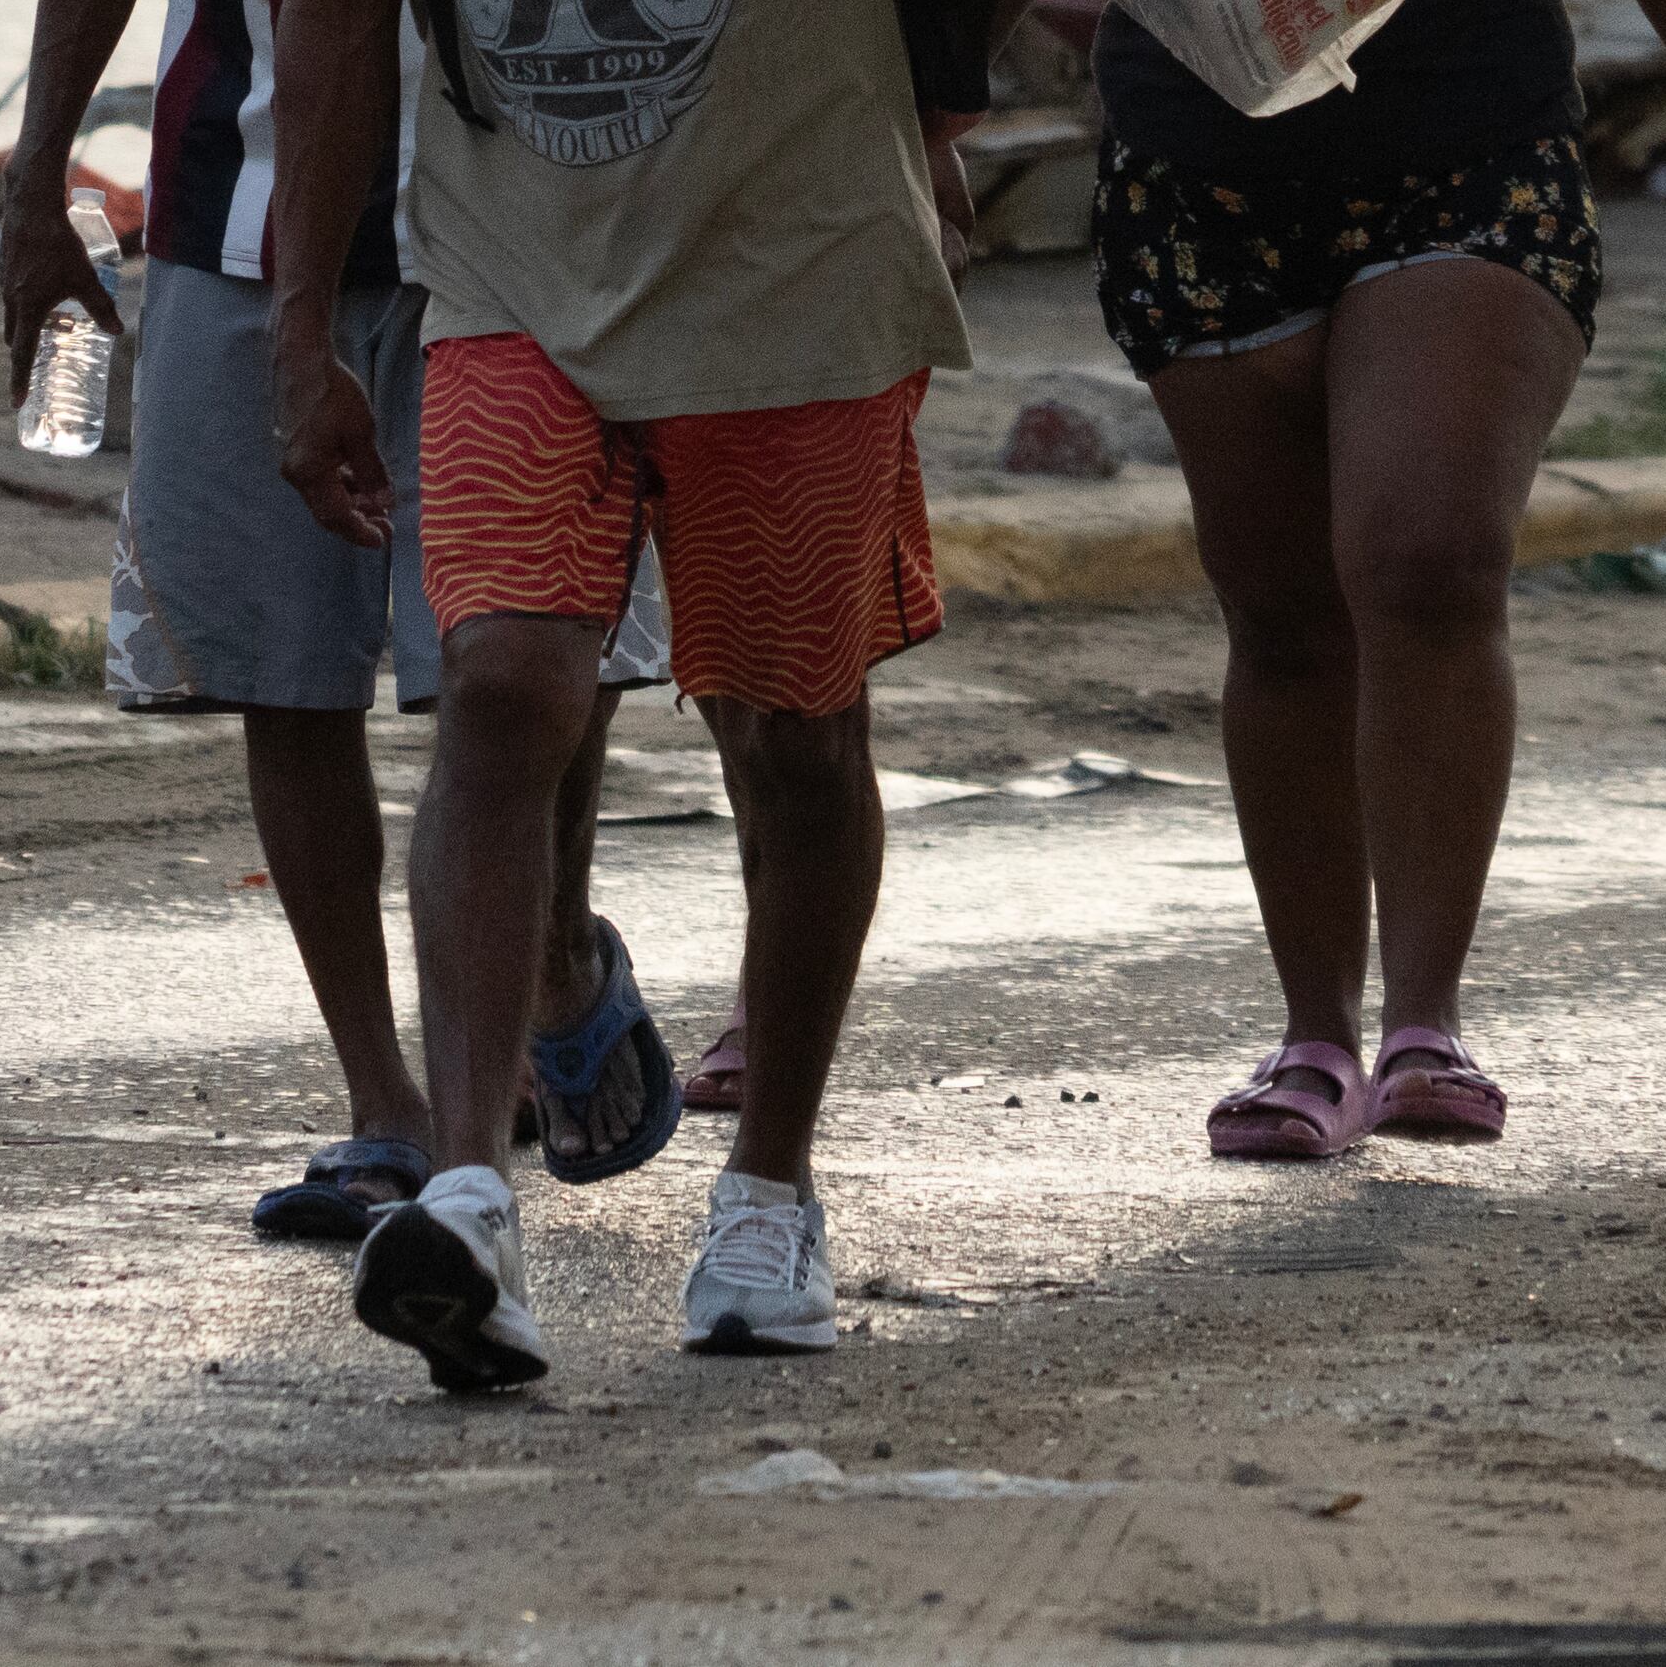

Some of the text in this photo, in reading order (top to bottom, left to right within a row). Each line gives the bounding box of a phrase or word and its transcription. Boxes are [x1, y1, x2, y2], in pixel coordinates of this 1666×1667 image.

[504, 50, 667, 83] EST. 1999
[538, 117, 643, 163] YOUTH
